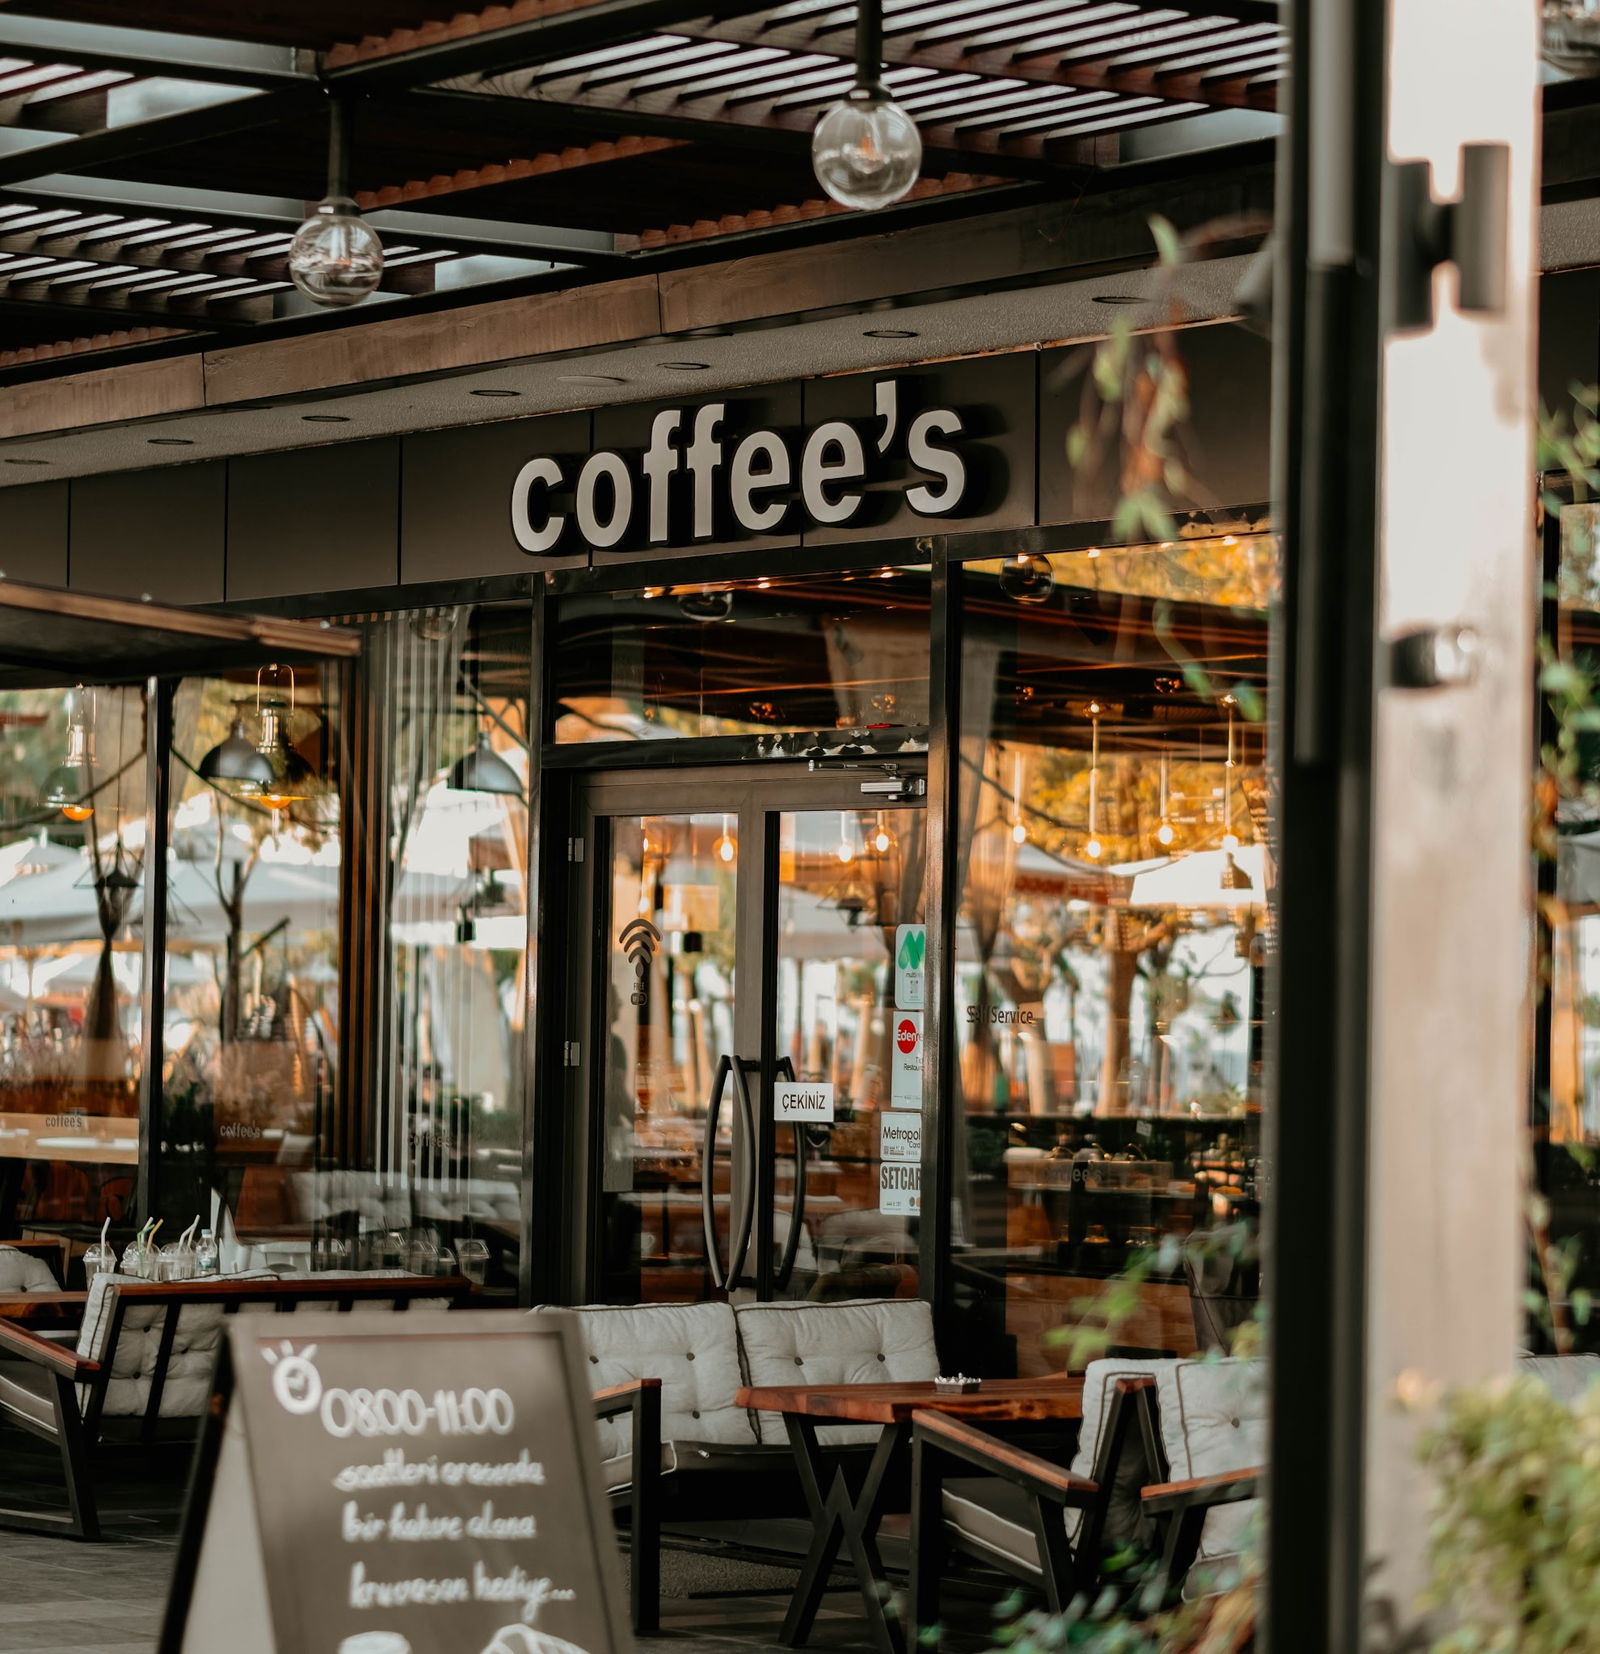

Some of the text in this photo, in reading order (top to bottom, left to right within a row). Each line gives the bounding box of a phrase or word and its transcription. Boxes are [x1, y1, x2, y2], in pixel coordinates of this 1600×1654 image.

[511, 379, 967, 554] coffee's
[991, 1004, 1034, 1024] Service
[782, 1090, 826, 1112] ÇEKİNİZ
[45, 1113, 83, 1129] coffee's
[220, 1121, 261, 1139] coffee's
